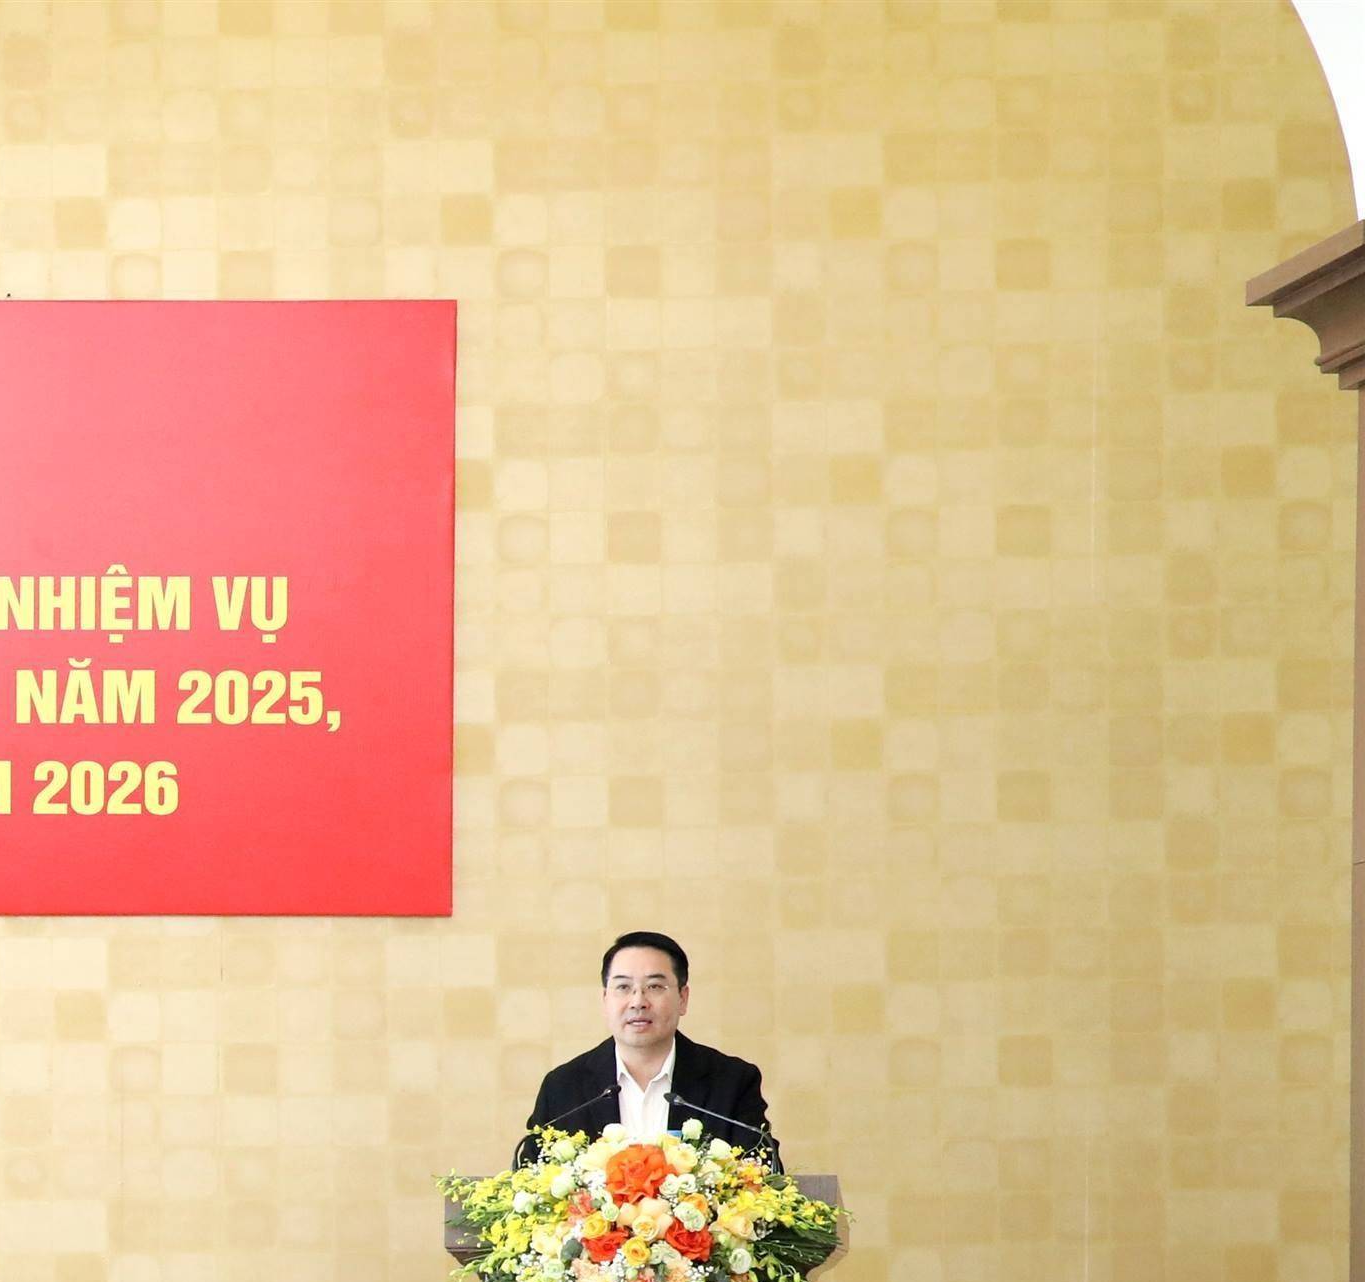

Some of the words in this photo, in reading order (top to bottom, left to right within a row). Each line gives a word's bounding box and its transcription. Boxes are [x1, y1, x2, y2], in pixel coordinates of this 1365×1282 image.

[212, 576, 289, 643] VỤ
[15, 658, 157, 726] NĂM
[175, 666, 341, 733] 2025,
[31, 760, 180, 816] 2026
